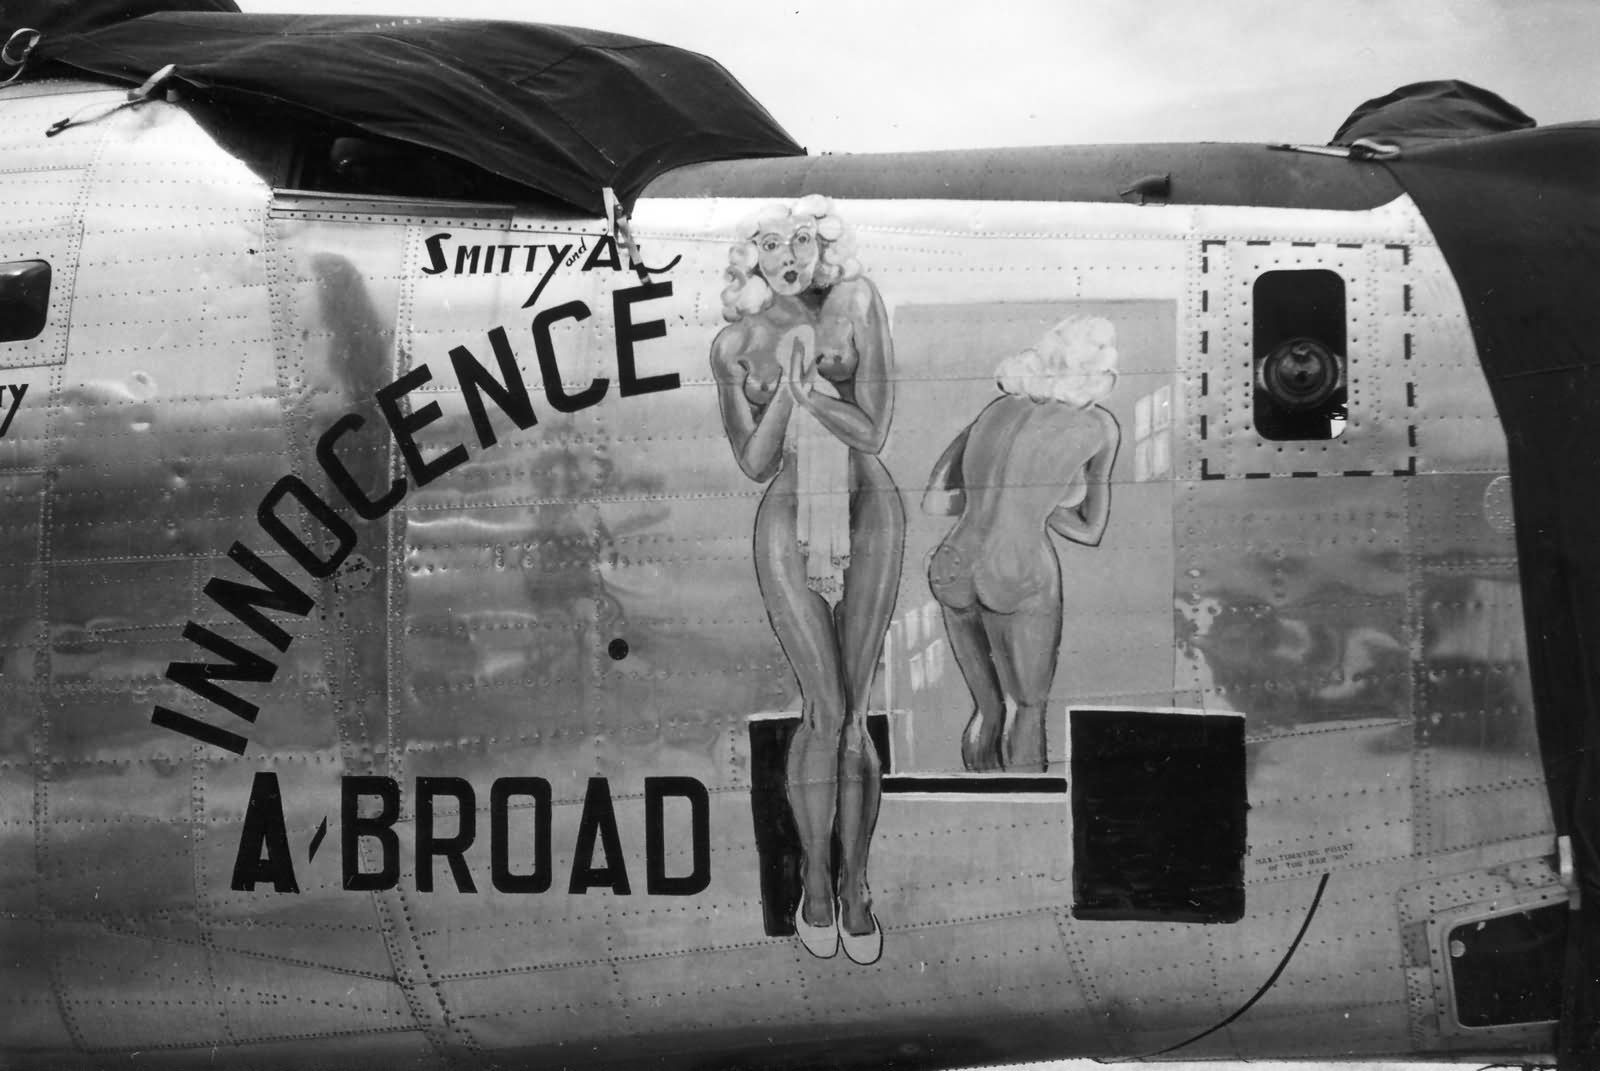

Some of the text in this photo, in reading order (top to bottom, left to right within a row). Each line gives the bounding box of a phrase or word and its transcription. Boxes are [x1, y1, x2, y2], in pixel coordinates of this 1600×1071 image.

[565, 236, 587, 267] and
[151, 281, 681, 755] INNOCENCE
[1323, 843, 1353, 854] POINT
